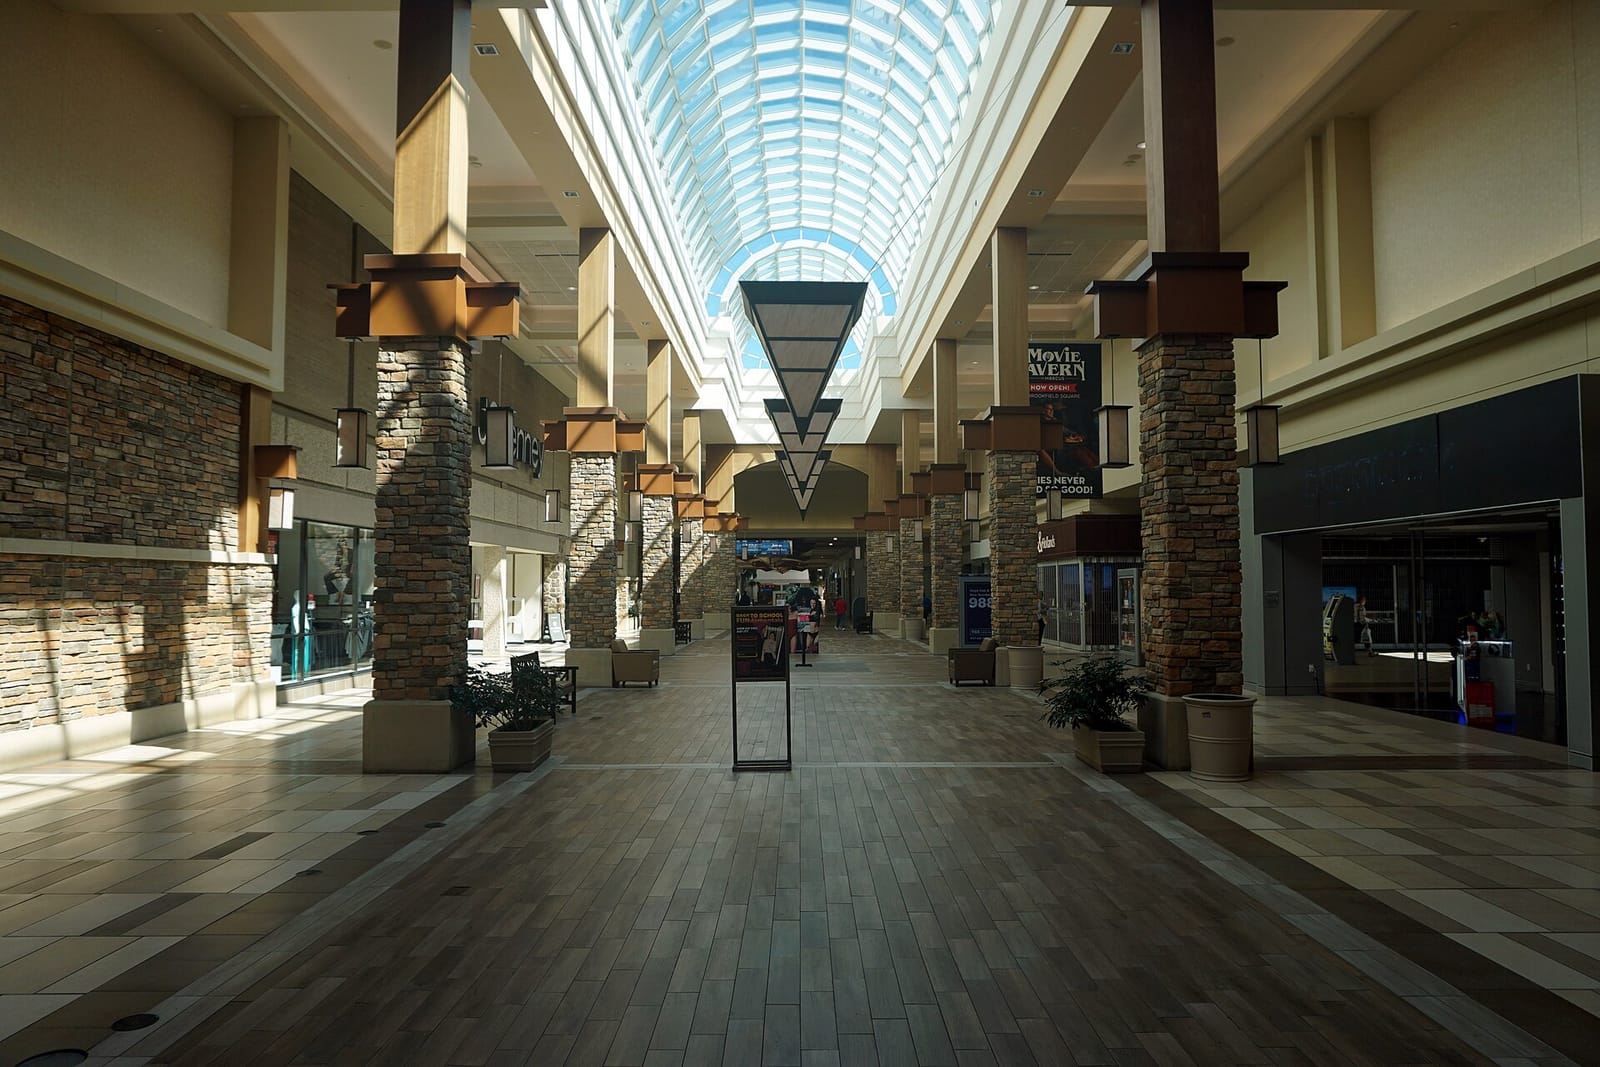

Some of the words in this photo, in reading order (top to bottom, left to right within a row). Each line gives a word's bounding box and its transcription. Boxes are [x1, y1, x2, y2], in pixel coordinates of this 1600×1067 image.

[1028, 361, 1086, 381] AVERN
[1054, 476, 1085, 485] NEVER
[1061, 485, 1093, 494] GOOD!
[968, 597, 992, 608] 988
